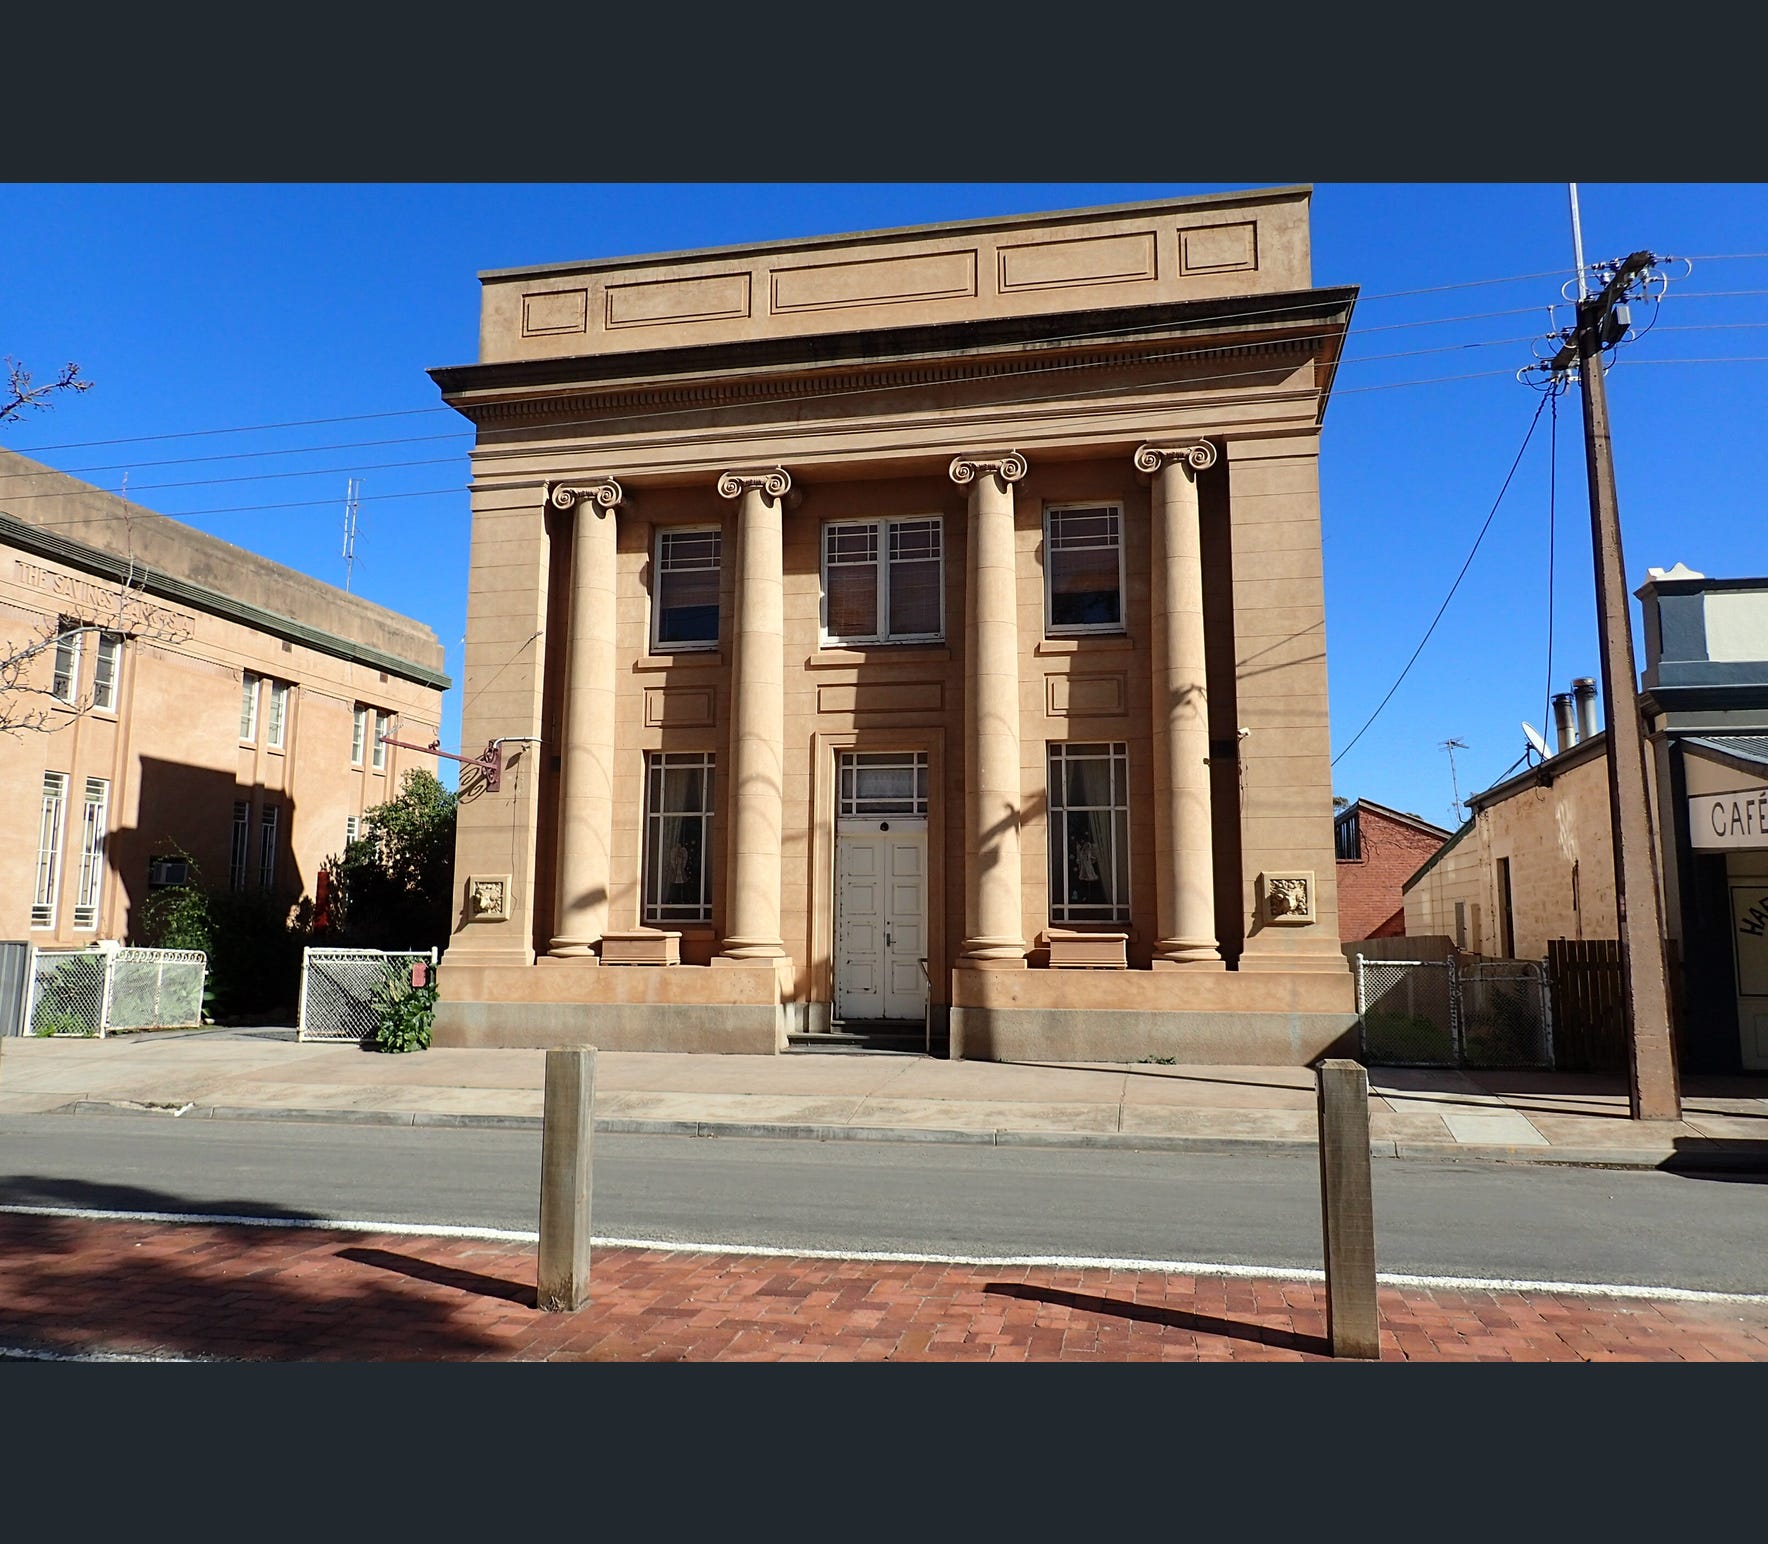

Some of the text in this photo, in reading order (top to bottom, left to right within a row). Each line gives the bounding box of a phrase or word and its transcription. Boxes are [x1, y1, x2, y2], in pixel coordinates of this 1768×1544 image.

[18, 563, 48, 589] THE
[53, 575, 116, 609] SAVINGS
[1711, 792, 1768, 837] CAFÉ
